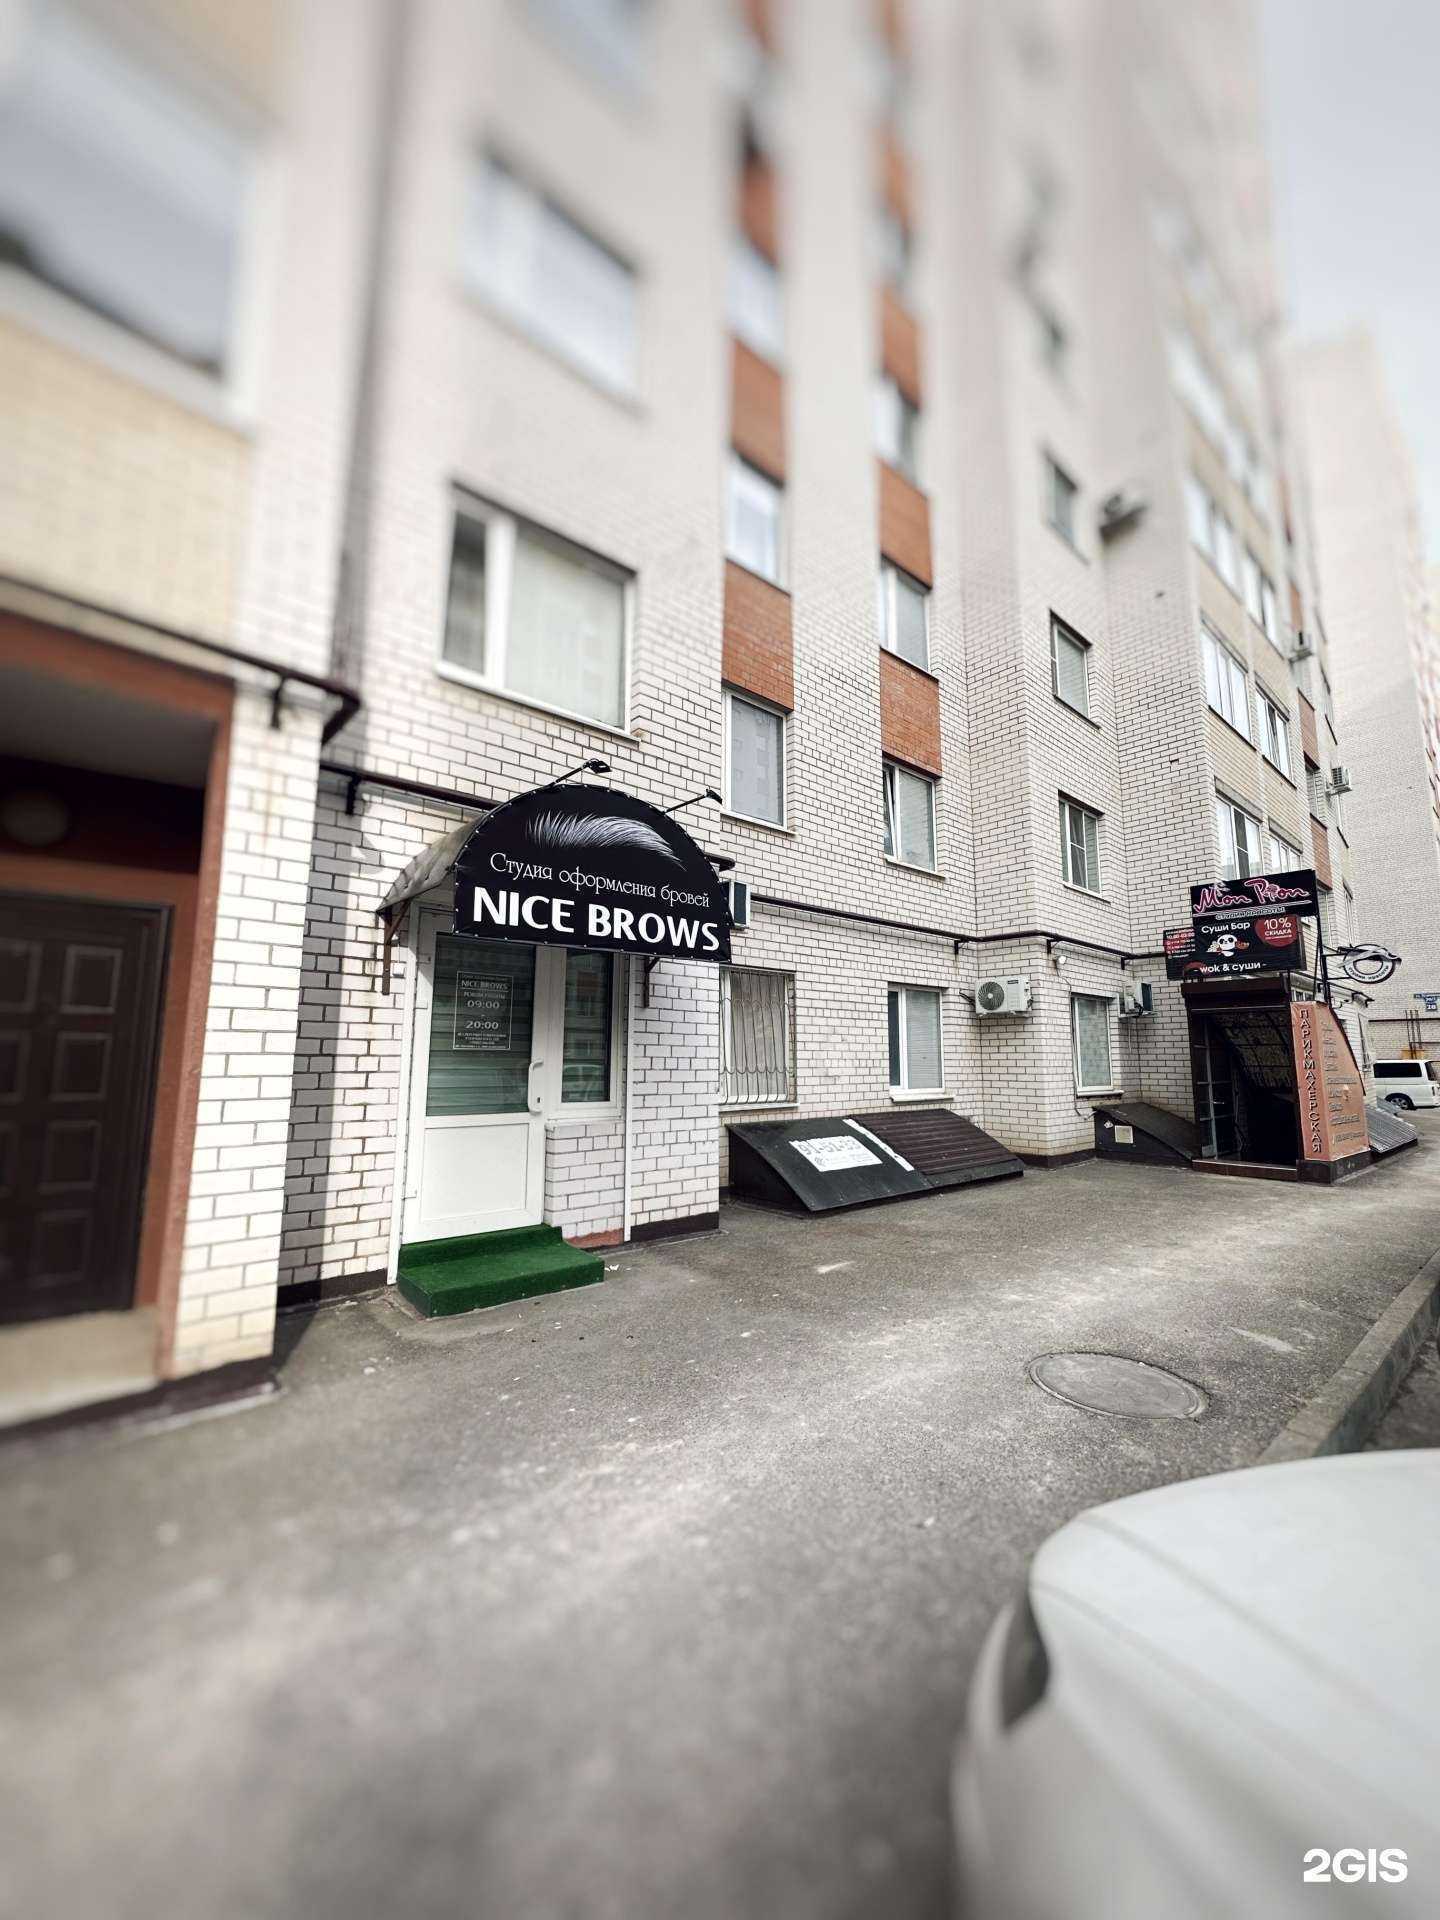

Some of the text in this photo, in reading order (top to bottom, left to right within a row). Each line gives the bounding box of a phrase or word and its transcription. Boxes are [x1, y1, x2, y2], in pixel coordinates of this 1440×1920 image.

[490, 852, 710, 908] Студия оформления бровей
[1193, 887, 1252, 913] Mon
[473, 886, 721, 951] NICE BROWS
[1201, 924, 1229, 934] Суши
[1231, 922, 1251, 931] Бар
[1265, 929, 1292, 937] СКИДКА
[1200, 963, 1220, 973] wok
[1232, 962, 1261, 974] суши
[467, 1000, 500, 1009] 09:00
[465, 1020, 499, 1030] 20:00
[1300, 1009, 1322, 1153] ПАРИКМАХЕРСКАЯ
